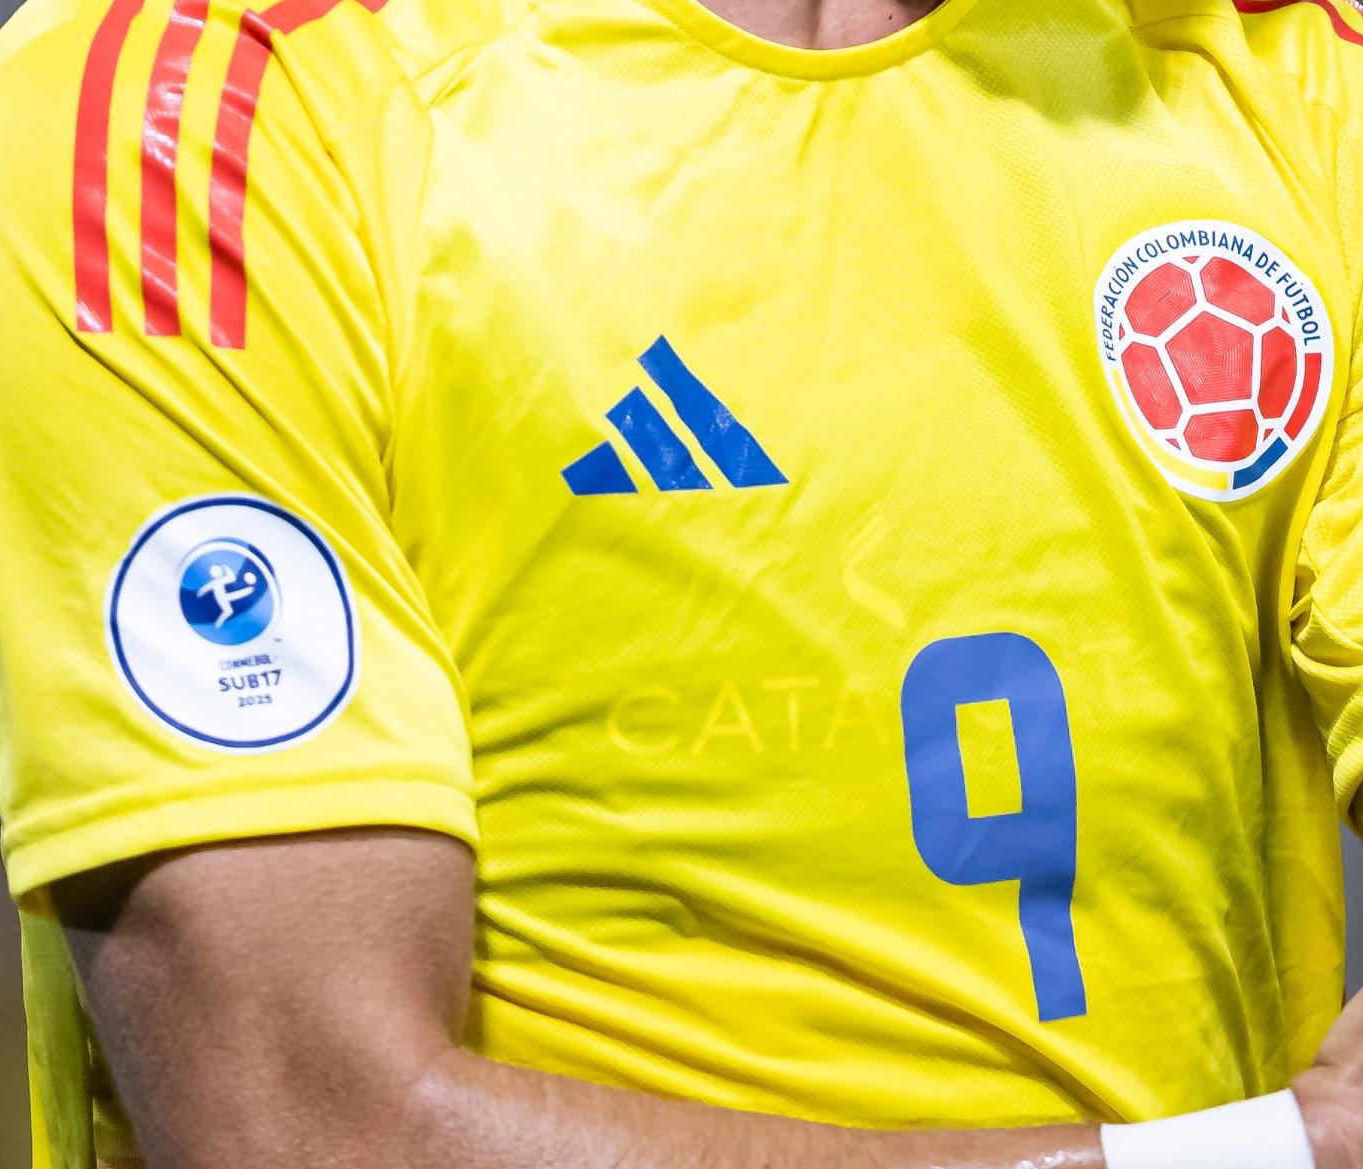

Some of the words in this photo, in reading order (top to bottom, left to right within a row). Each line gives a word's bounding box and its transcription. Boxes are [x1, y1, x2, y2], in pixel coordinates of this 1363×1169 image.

[1101, 256, 1139, 362] FEDERACIÓN
[1136, 229, 1254, 264] COLOMBIANA
[1255, 251, 1281, 278] DE
[1276, 271, 1322, 347] FÚTBOL
[218, 669, 282, 692] SUB17
[900, 631, 1088, 1023] 9
